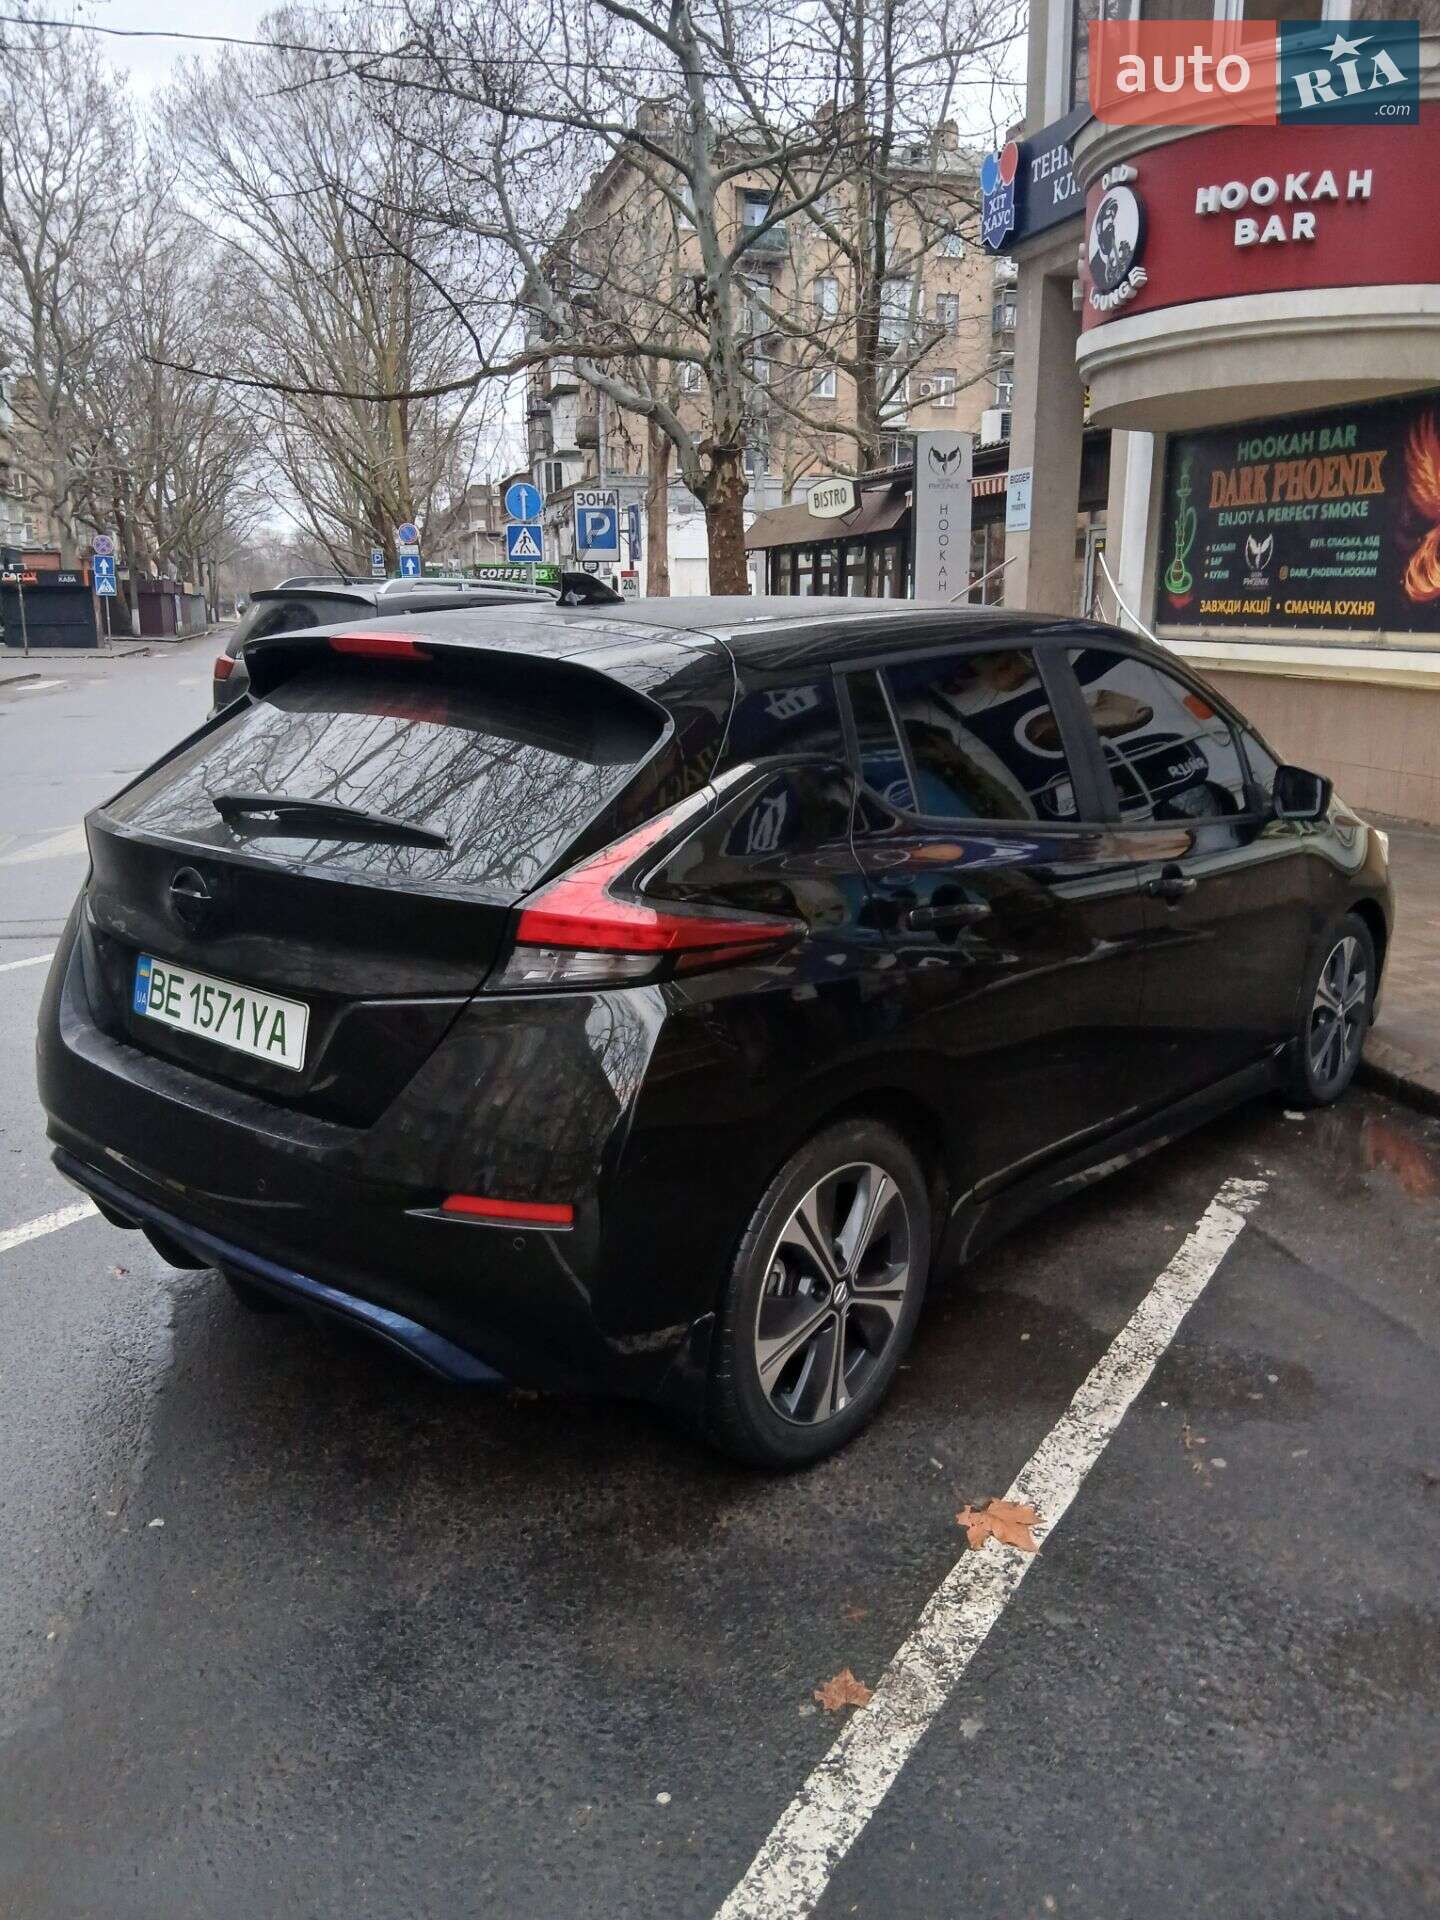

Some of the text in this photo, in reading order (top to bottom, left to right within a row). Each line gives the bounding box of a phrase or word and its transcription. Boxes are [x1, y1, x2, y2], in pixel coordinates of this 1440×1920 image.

[1195, 169, 1373, 215] HOOKAH
[1234, 212, 1316, 247] BAR
[1237, 425, 1358, 462] HOOKAH BAR
[1208, 450, 1388, 509] DARK PHOENIX
[576, 492, 616, 507] ЗОНА
[813, 486, 848, 509] BISTRO
[1218, 500, 1369, 527] ENJOY A PERFECT SMOKE
[937, 503, 950, 592] HOOKAH
[479, 568, 528, 580] COFFEE
[1200, 596, 1376, 616] ЗАВЖДИ АКЦІЇ СМАЧНА КУХНЯ
